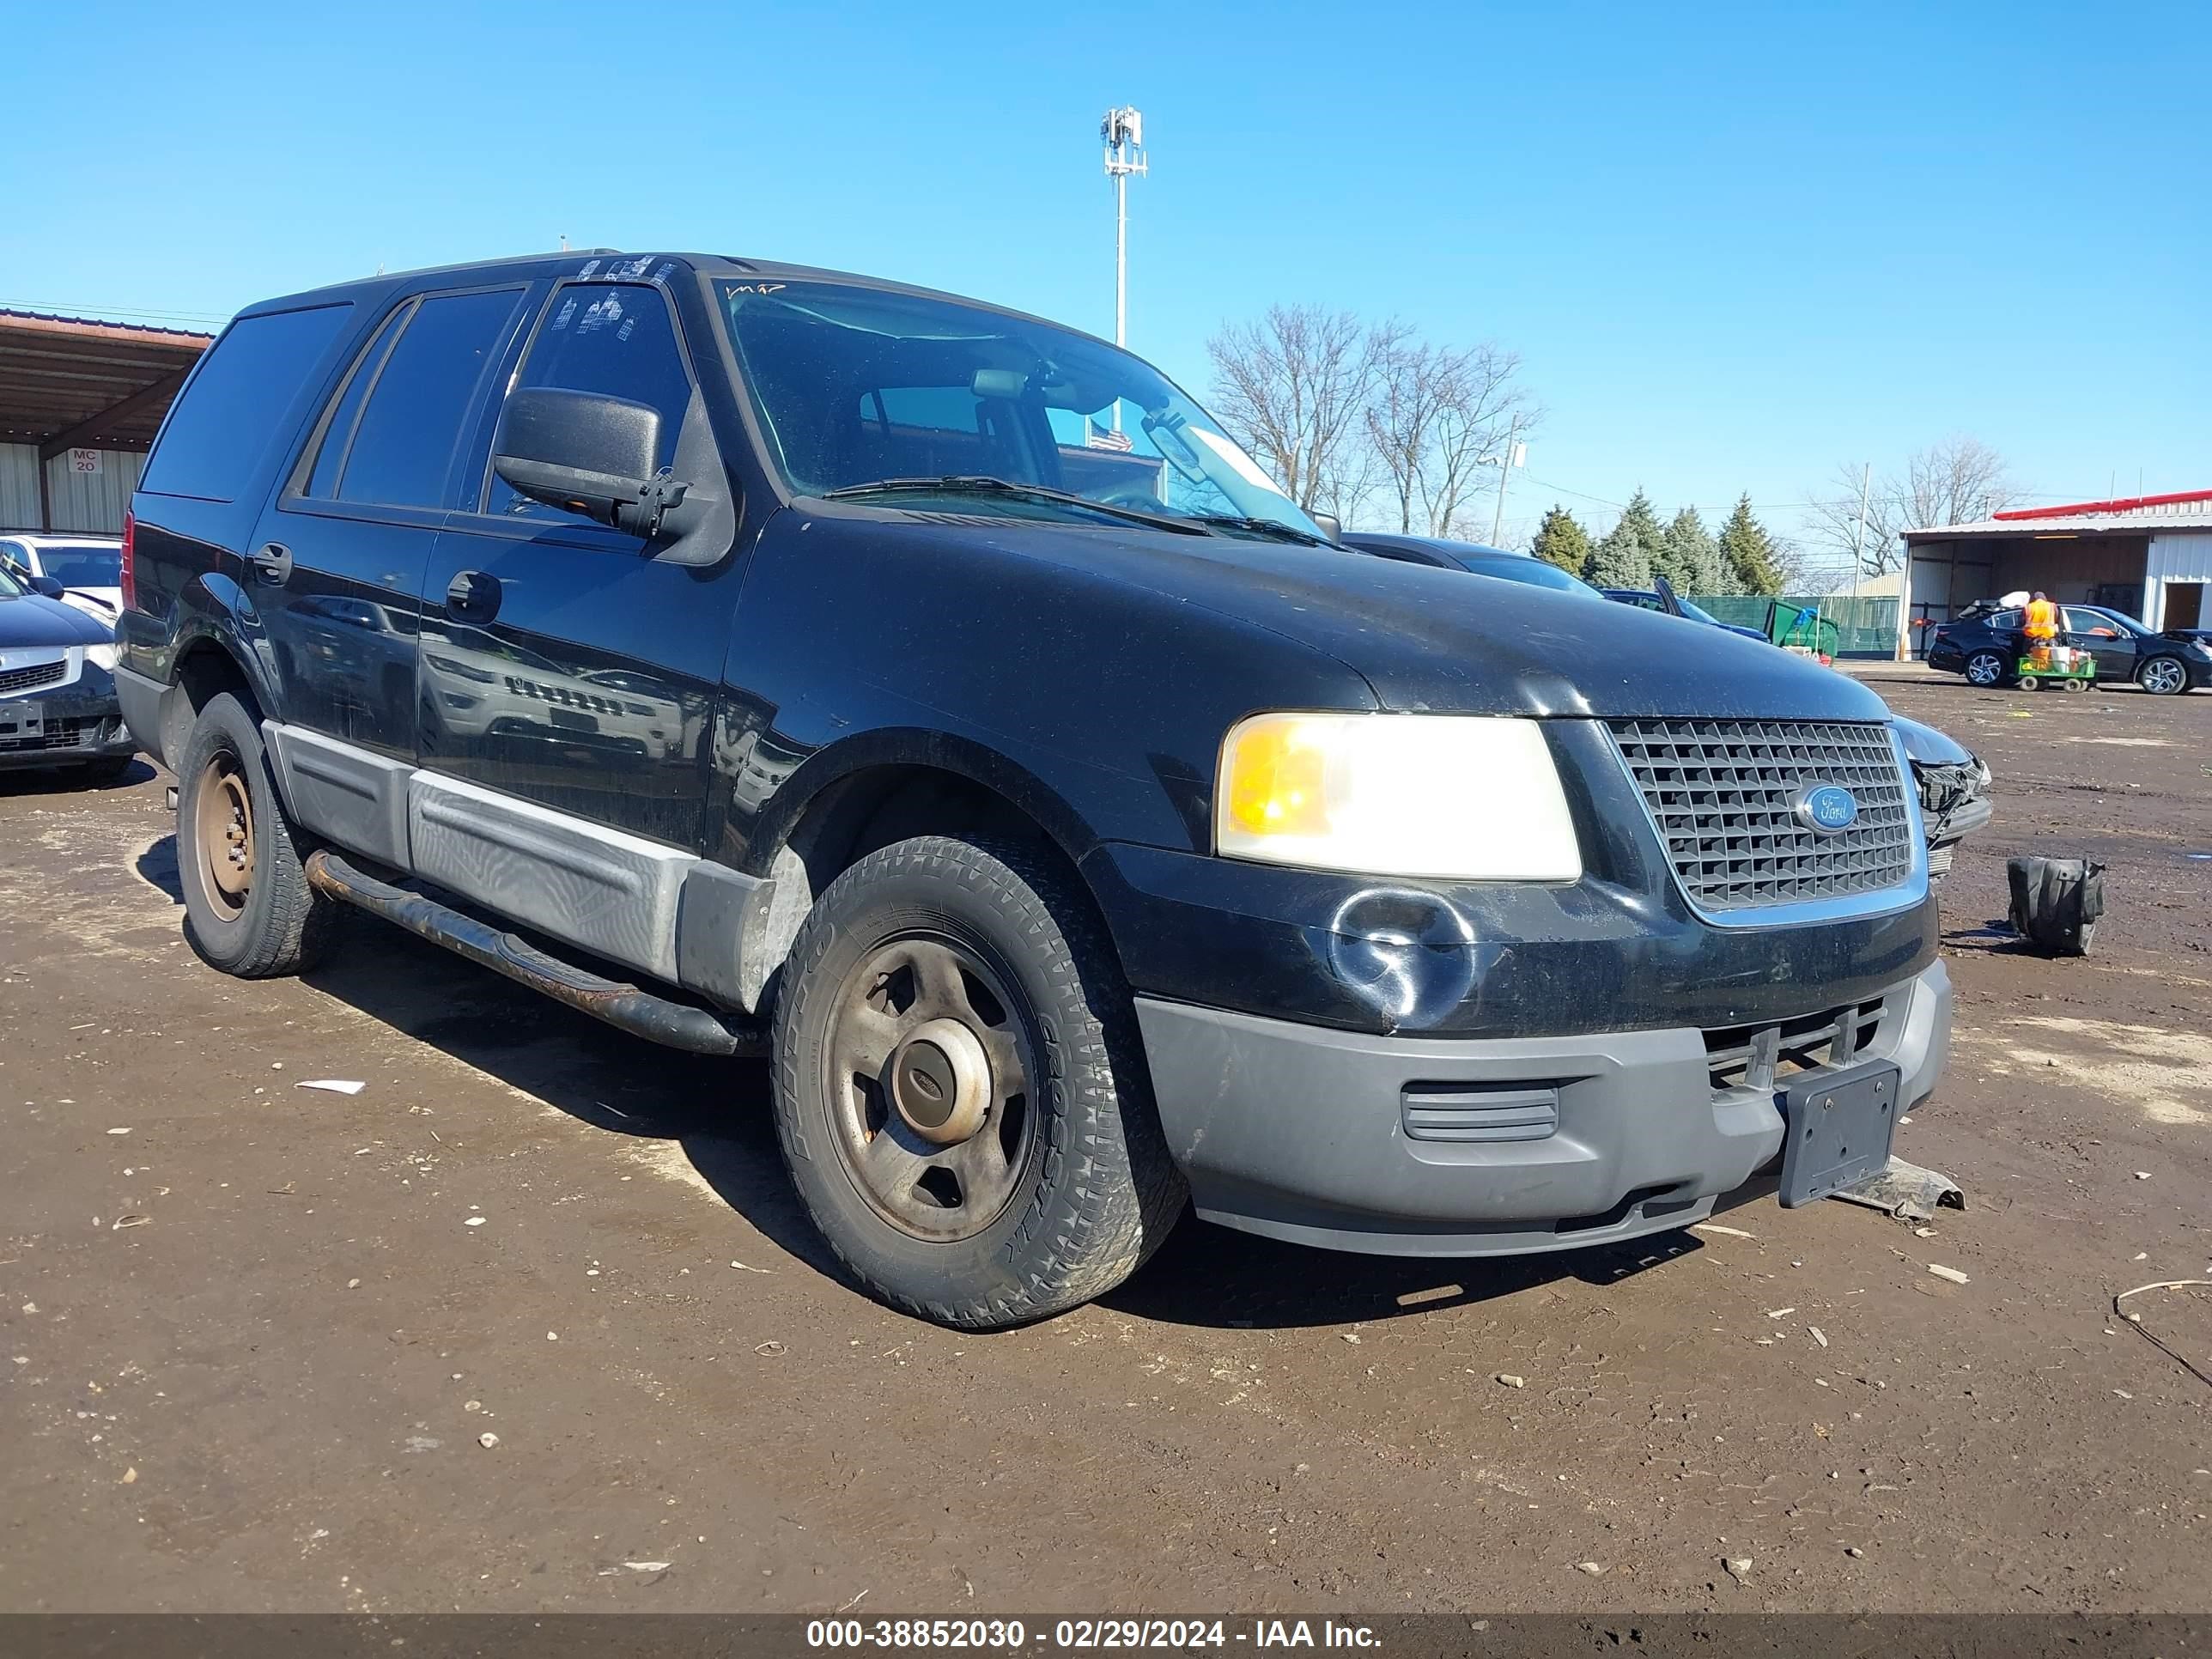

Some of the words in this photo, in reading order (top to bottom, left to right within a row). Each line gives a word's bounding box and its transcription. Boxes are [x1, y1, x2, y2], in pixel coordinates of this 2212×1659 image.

[74, 450, 96, 460] MC
[76, 461, 95, 471] 20
[1820, 794, 1848, 821] Ford
